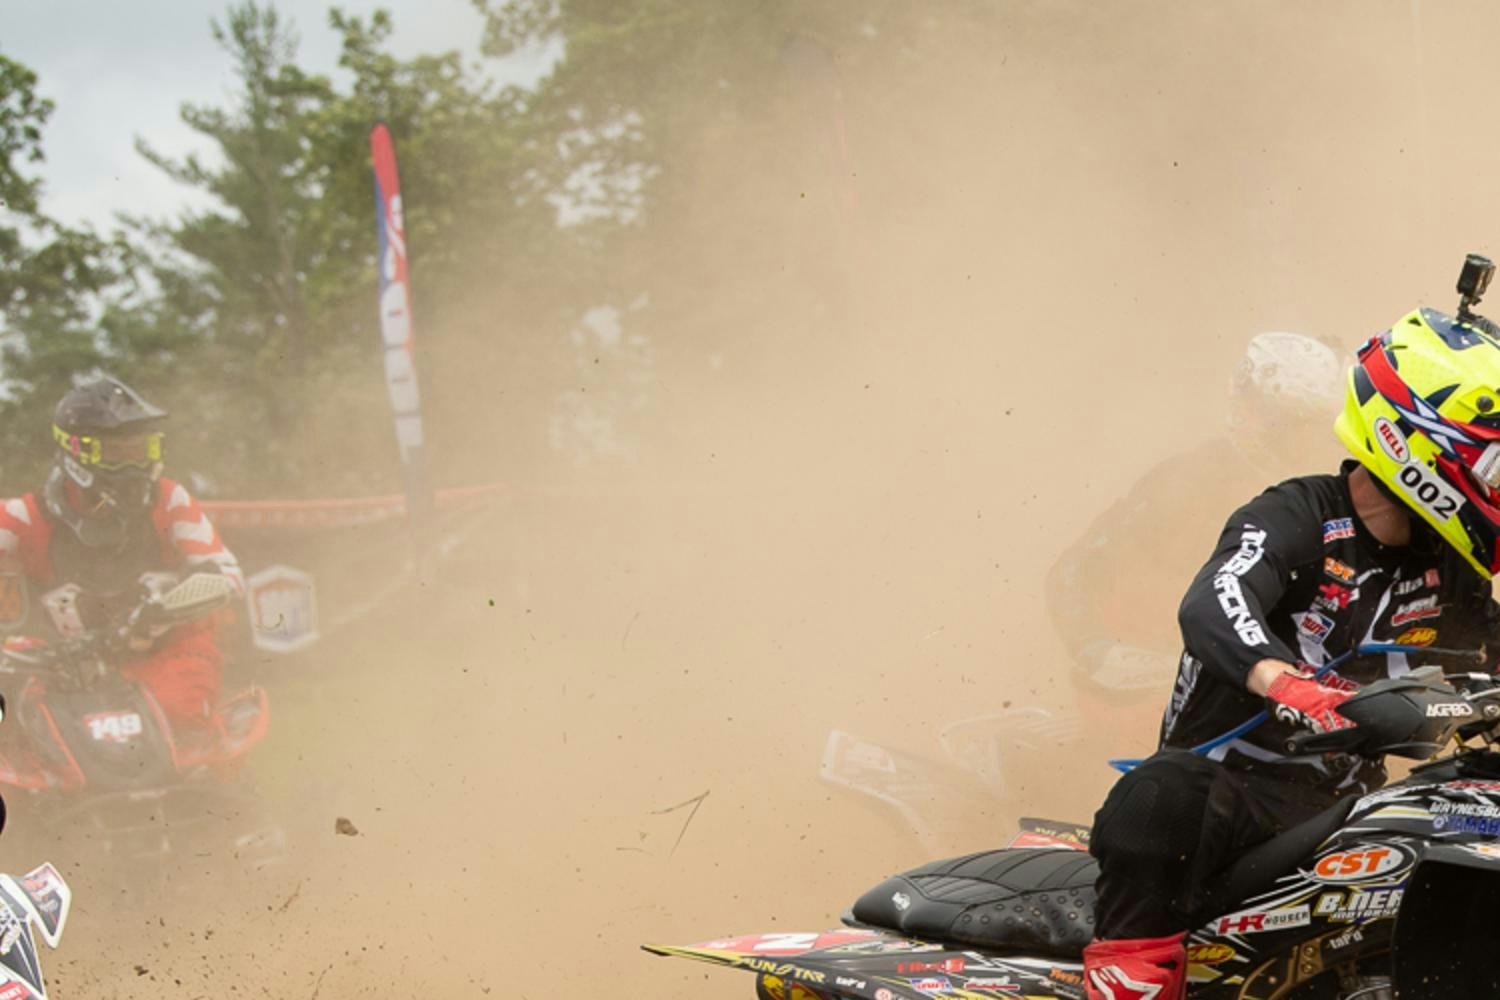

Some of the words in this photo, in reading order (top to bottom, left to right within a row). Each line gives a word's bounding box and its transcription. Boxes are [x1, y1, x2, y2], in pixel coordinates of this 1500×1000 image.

[1378, 422, 1405, 459] BELL
[1400, 465, 1458, 520] 002
[1315, 849, 1391, 877] CST
[1219, 913, 1268, 935] HR
